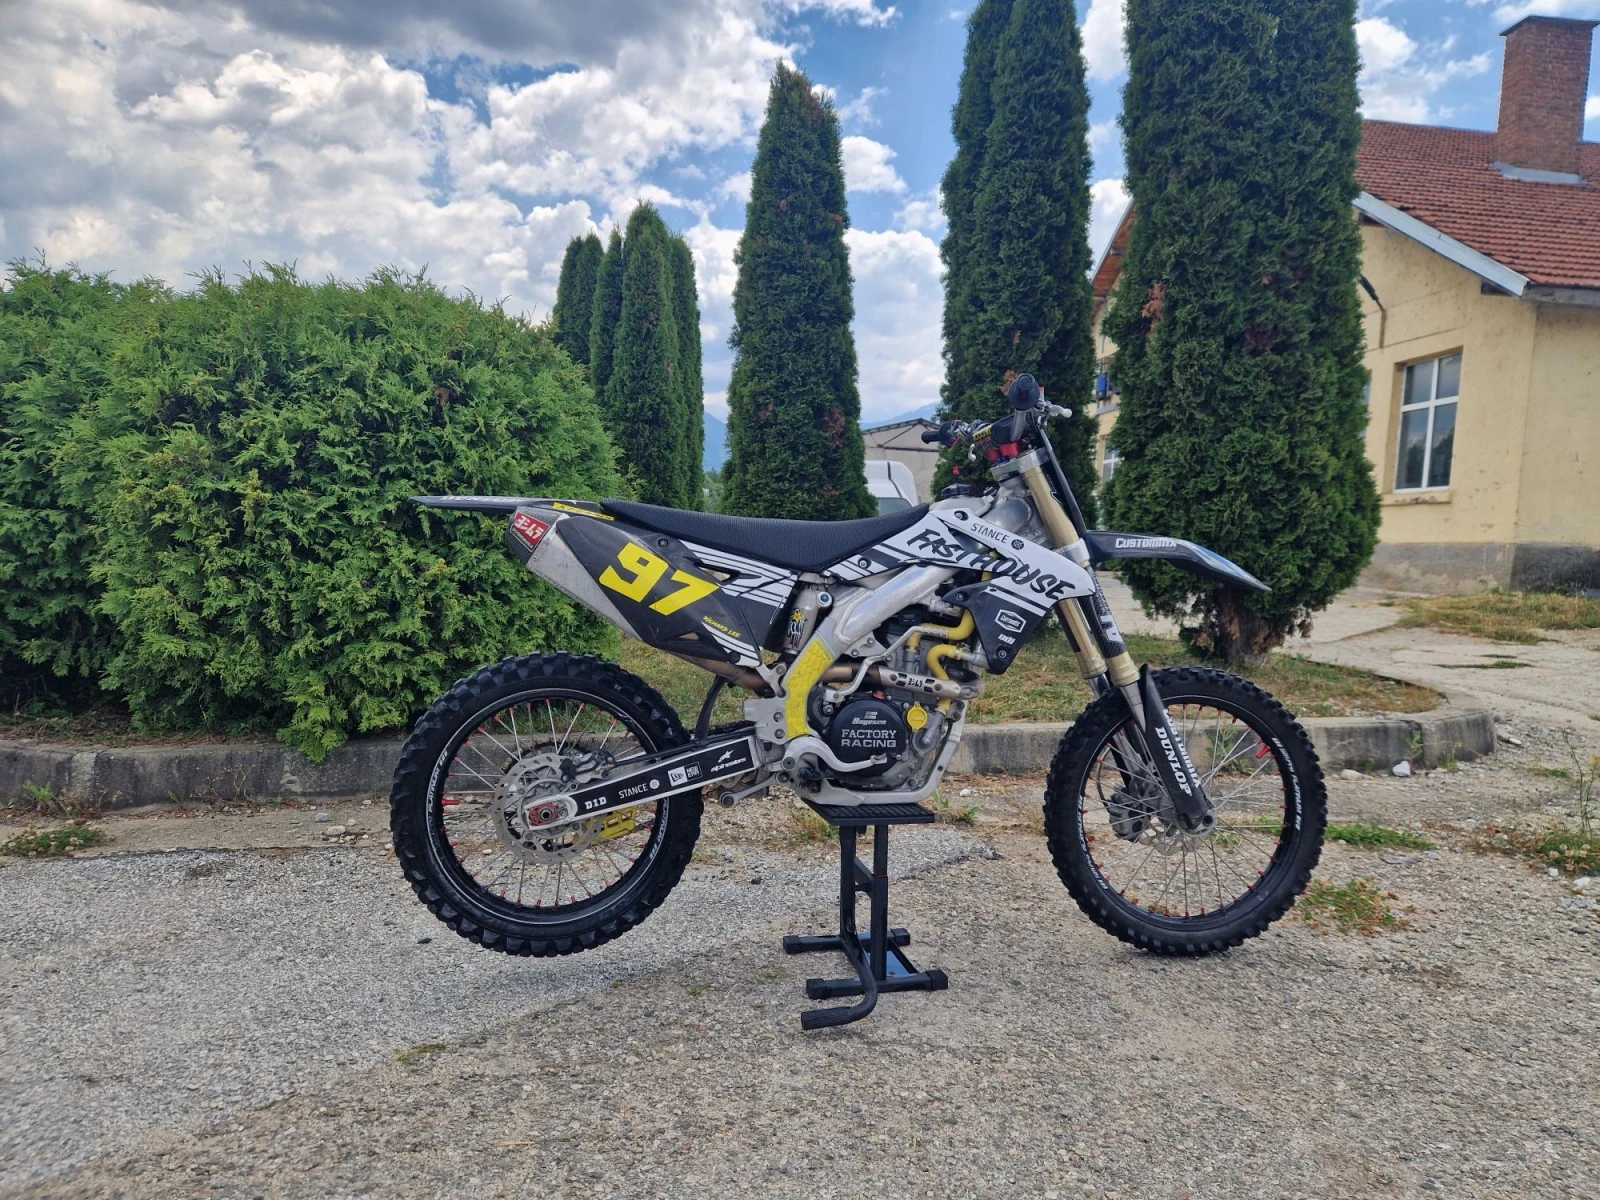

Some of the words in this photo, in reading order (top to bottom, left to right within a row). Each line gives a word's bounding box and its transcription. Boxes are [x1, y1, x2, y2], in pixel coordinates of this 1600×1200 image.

[970, 522, 1010, 544] STANCE
[907, 528, 1076, 600] FASTHOUSE
[599, 542, 719, 616] 97
[727, 629, 742, 638] LEE
[852, 717, 887, 725] Boyesen
[841, 729, 897, 739] FACTORY
[841, 739, 897, 748] RACING
[1155, 727, 1192, 796] DUNLOP
[618, 782, 649, 799] STANCE
[584, 796, 607, 810] DID
